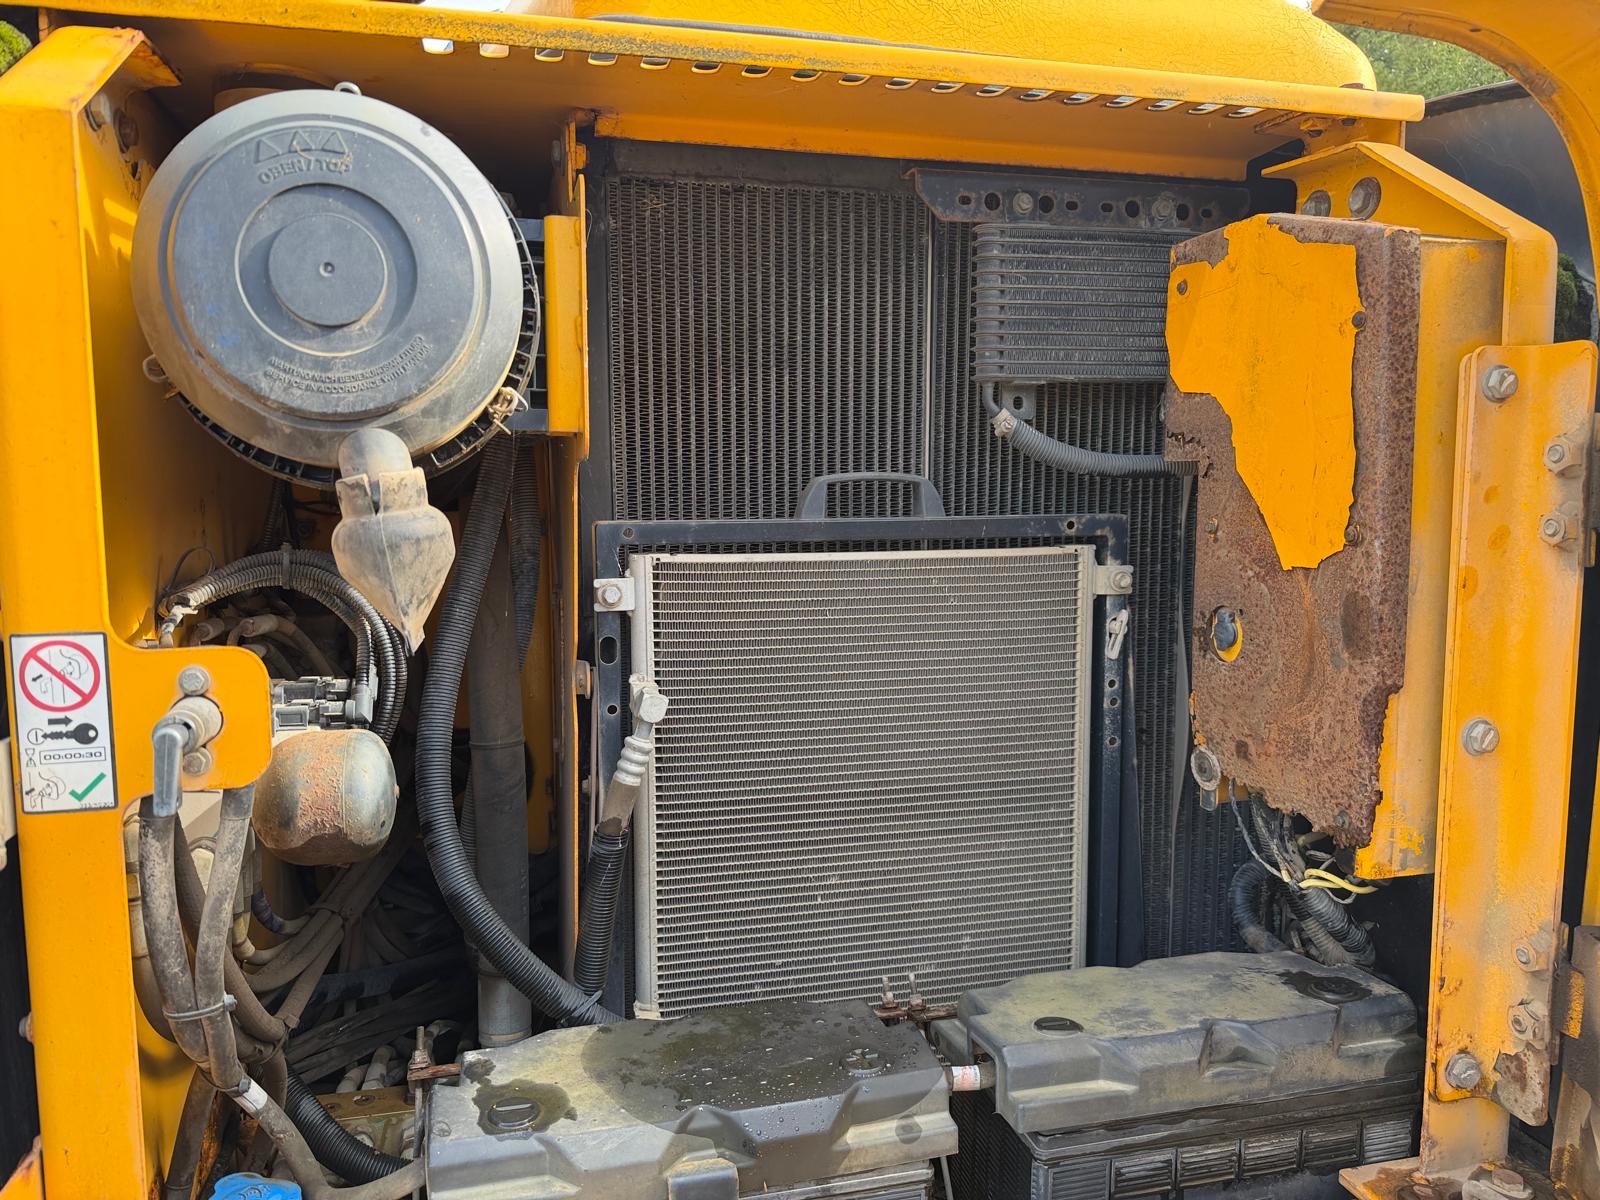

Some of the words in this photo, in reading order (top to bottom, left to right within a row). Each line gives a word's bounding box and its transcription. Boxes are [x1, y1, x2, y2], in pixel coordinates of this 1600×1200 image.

[264, 367, 305, 390] SERVICE
[305, 382, 318, 393] IN
[318, 378, 382, 394] ACCORDANCE
[313, 371, 338, 384] NACH
[43, 751, 102, 761] 00:00:30
